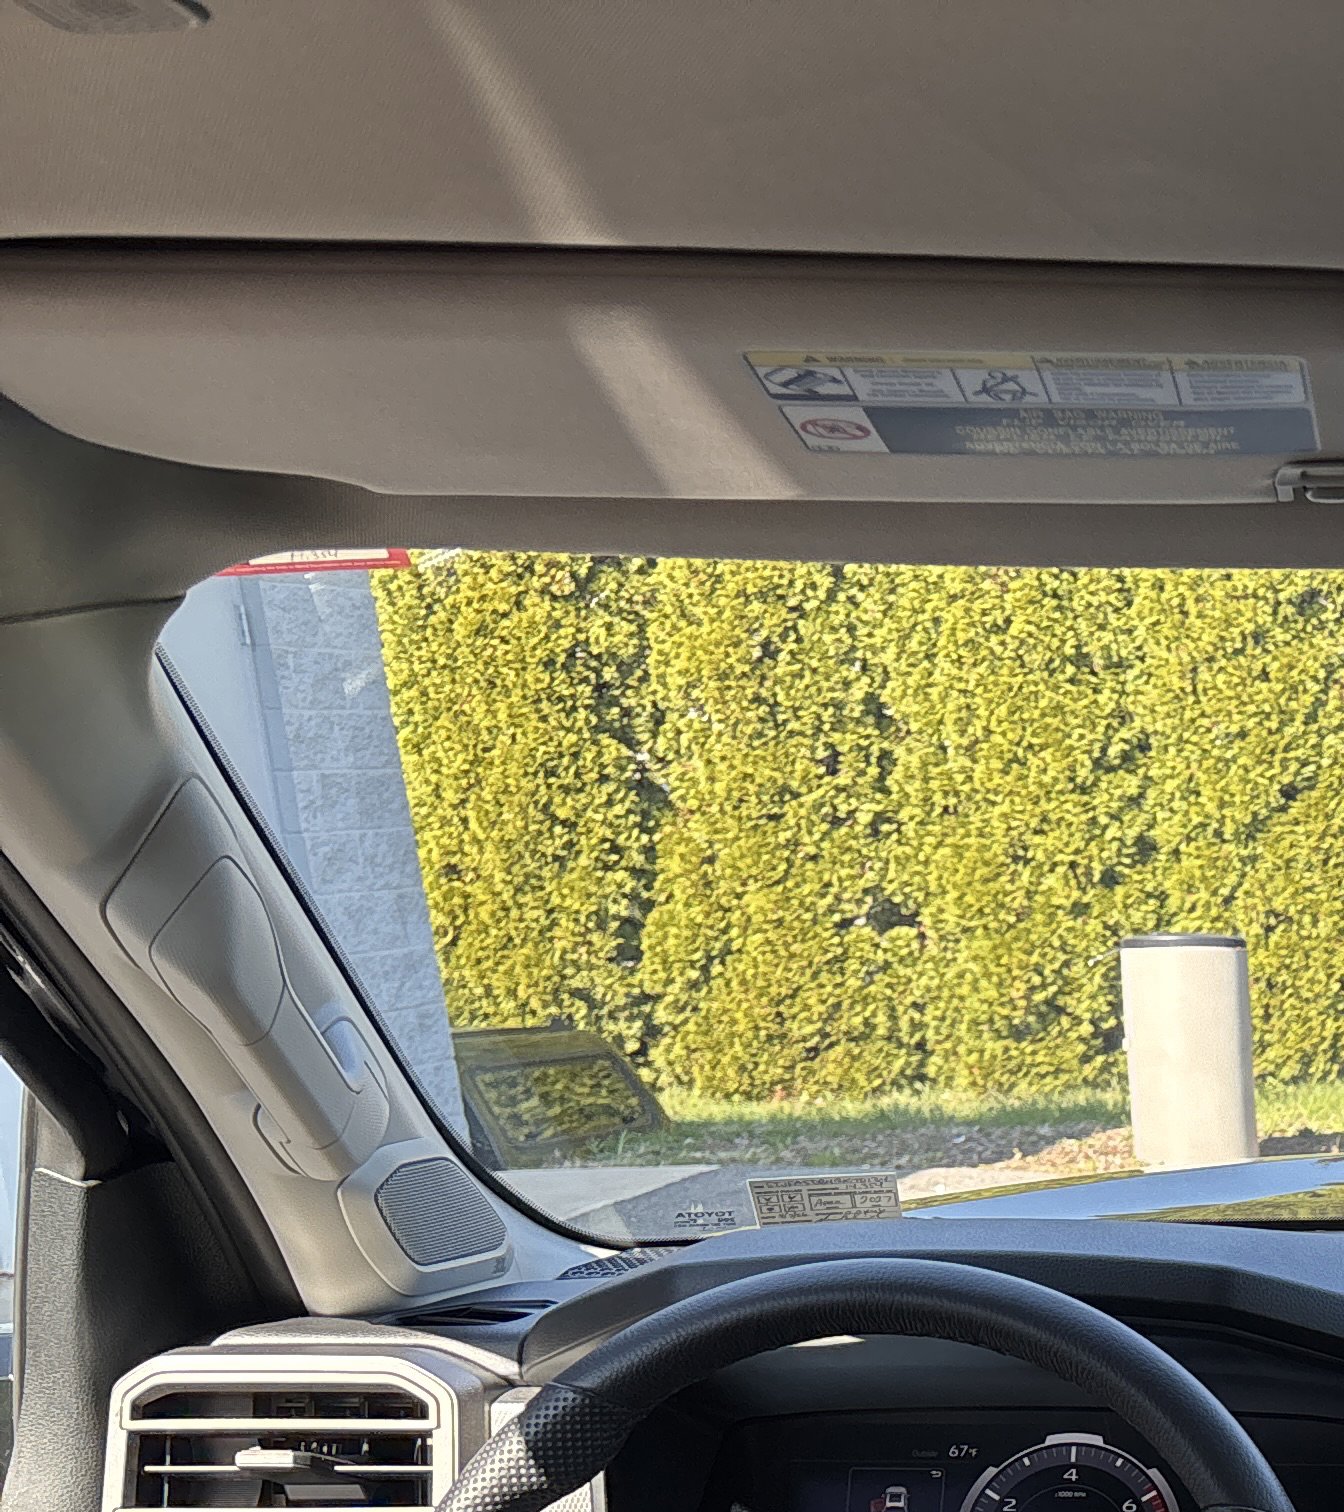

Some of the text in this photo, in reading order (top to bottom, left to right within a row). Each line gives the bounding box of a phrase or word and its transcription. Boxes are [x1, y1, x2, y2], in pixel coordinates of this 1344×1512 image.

[1062, 1467, 1079, 1482] 4
[1001, 1498, 1017, 1512] 2
[1122, 1499, 1137, 1512] 6
